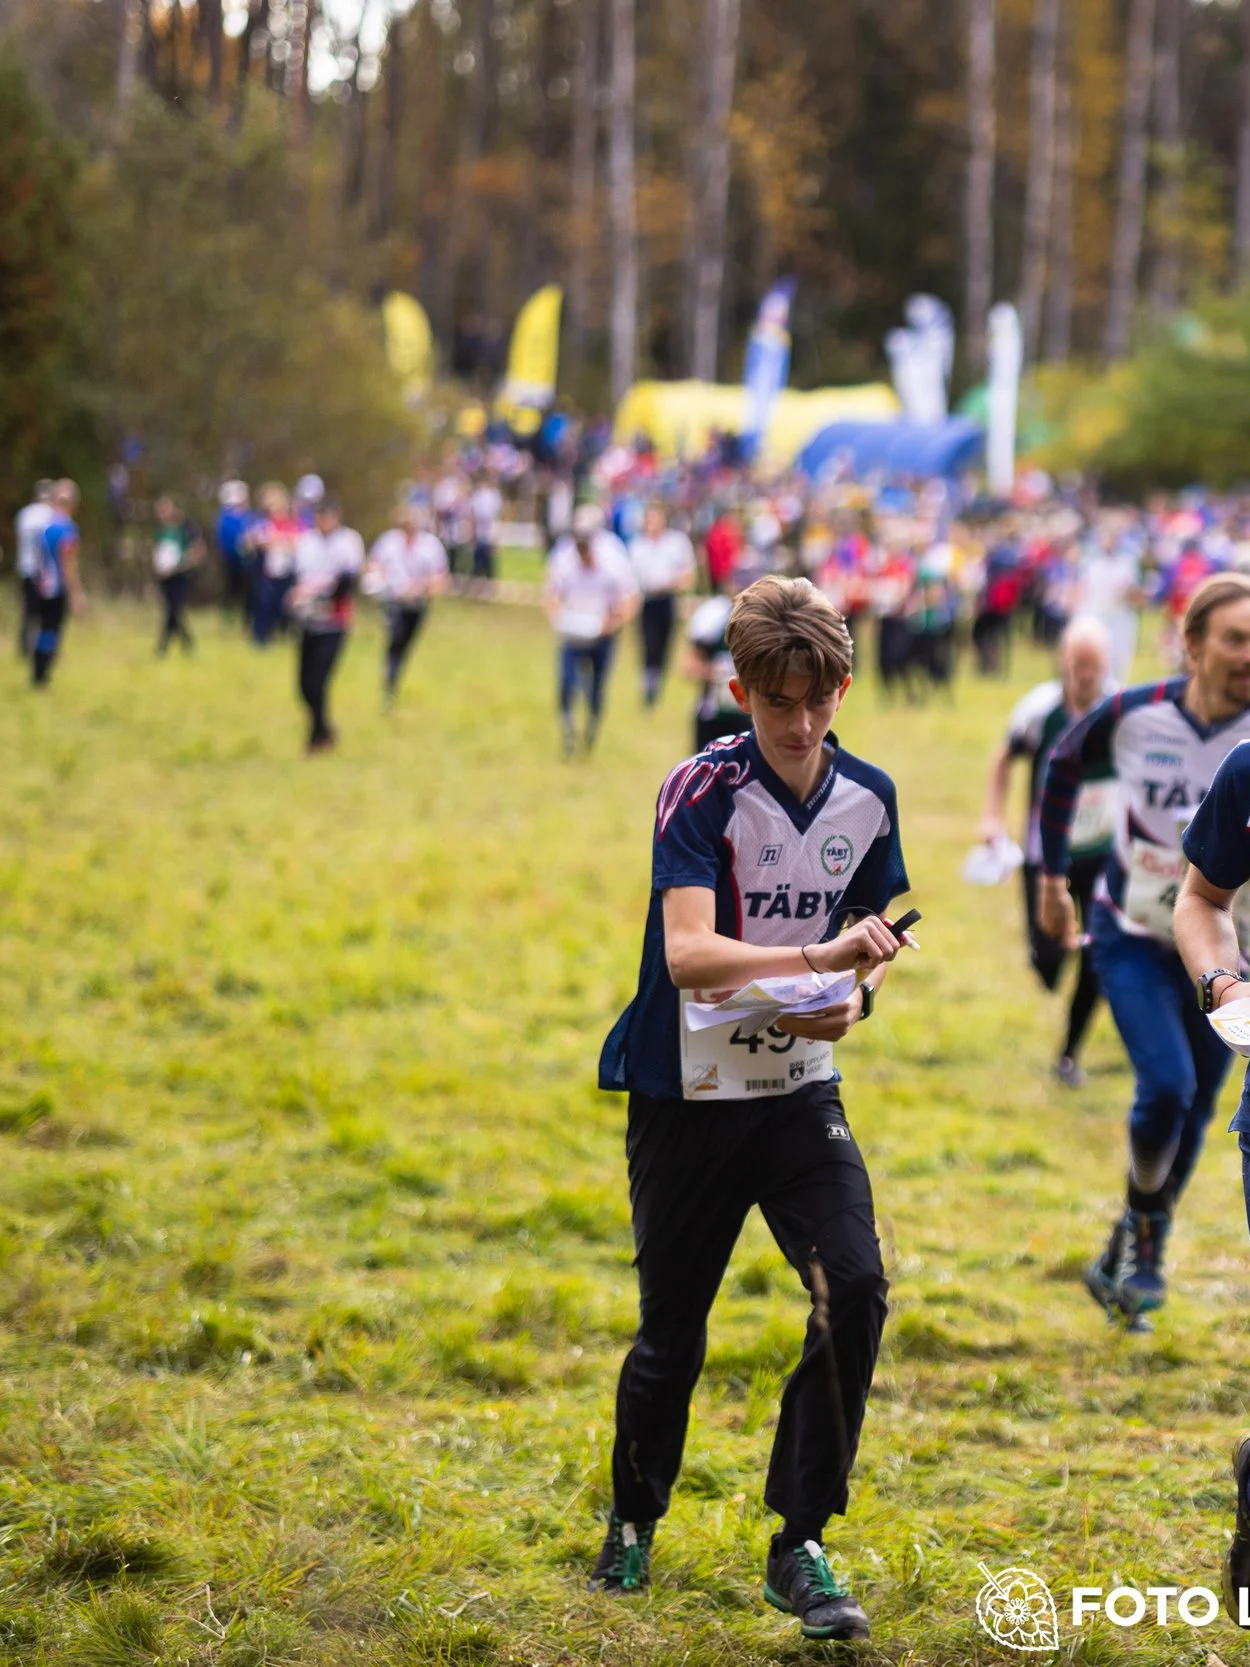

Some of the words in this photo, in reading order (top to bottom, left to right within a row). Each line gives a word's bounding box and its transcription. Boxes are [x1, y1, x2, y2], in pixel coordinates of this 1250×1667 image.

[1143, 777, 1207, 809] TÄ
[825, 847, 849, 857] TÄBY
[743, 883, 844, 920] TÄBY
